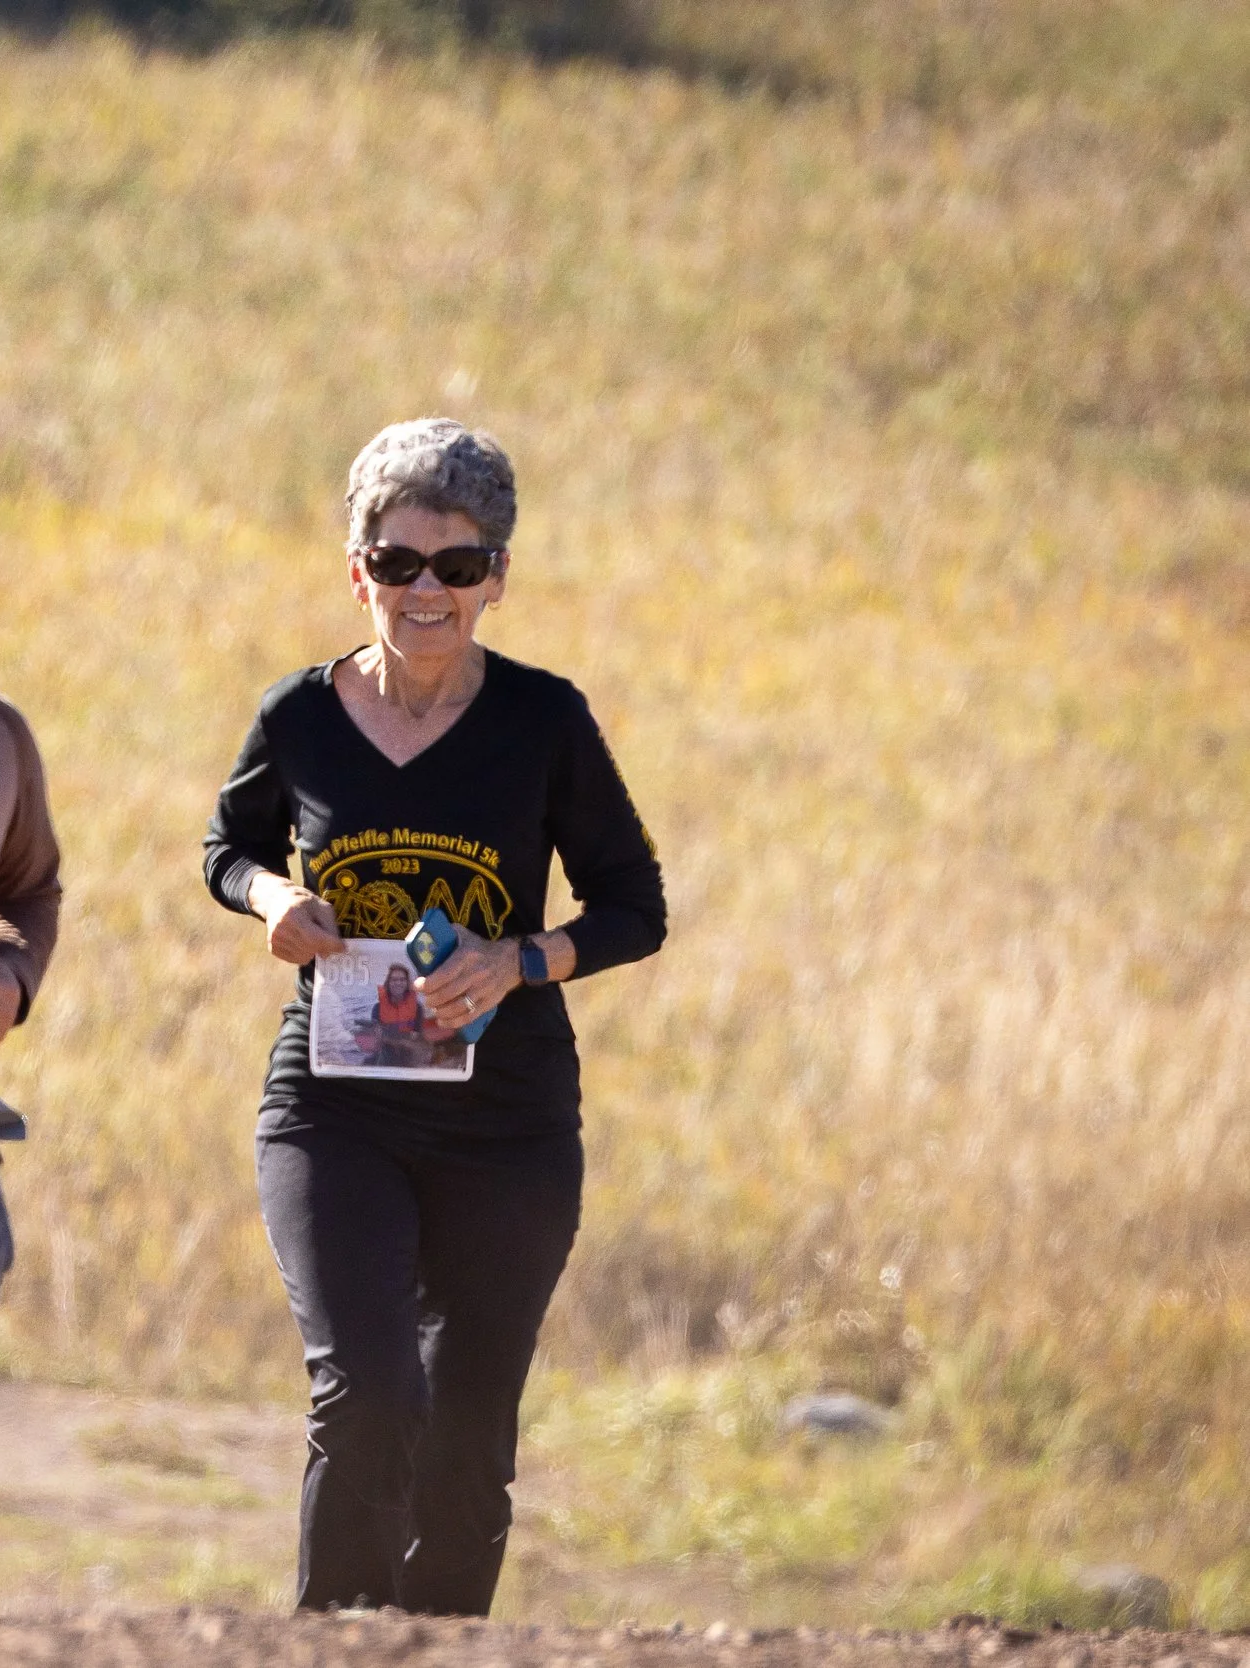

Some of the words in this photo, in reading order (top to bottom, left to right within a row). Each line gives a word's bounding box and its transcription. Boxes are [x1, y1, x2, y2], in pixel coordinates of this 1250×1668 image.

[391, 827, 479, 858] Memorial
[479, 845, 501, 869] 5k
[381, 857, 421, 874] 2023
